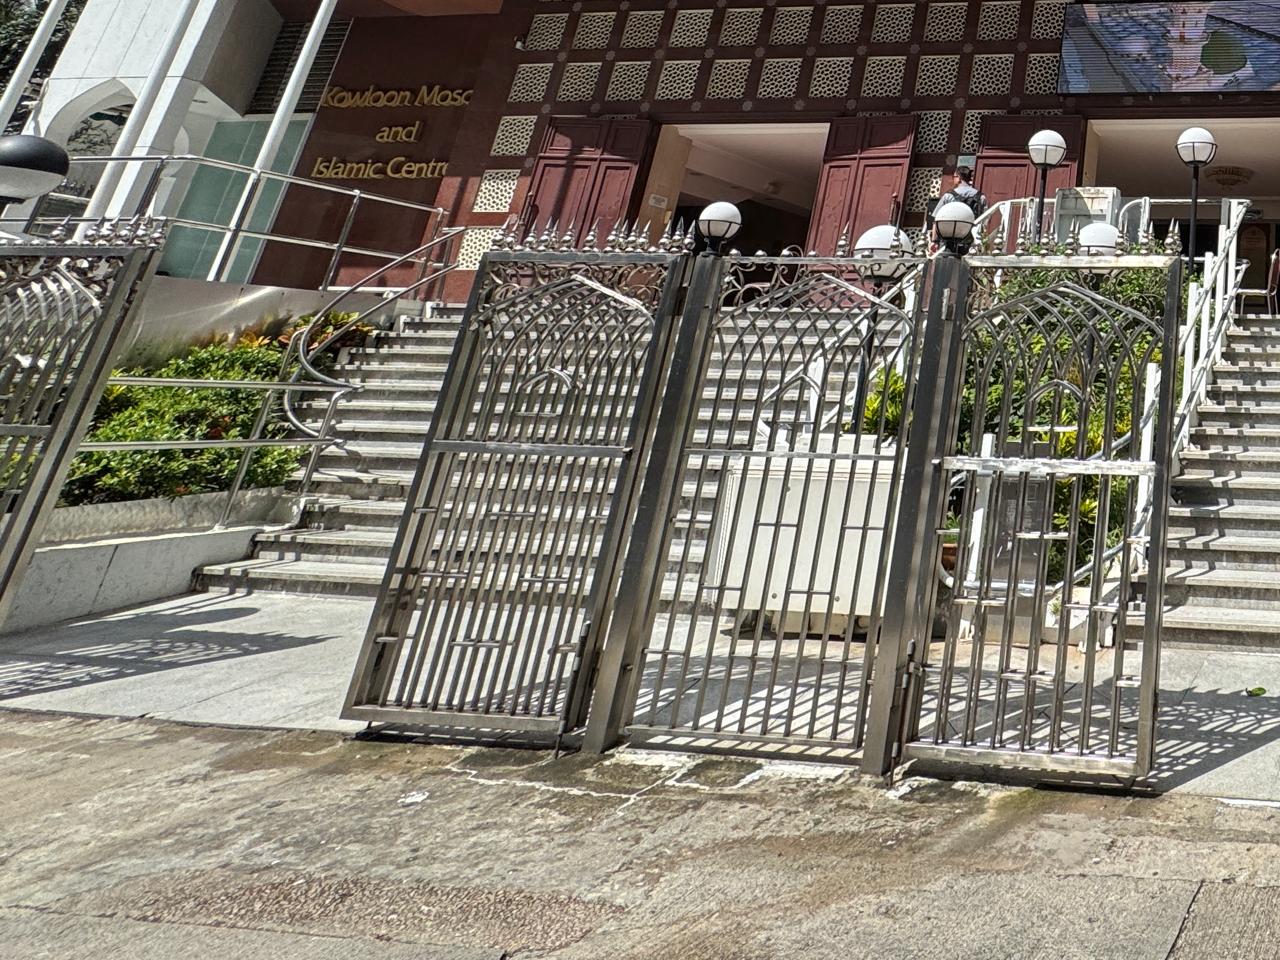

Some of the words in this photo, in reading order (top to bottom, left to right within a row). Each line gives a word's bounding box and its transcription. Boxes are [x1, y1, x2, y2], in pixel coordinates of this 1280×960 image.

[320, 85, 411, 108] Kowloon
[375, 120, 420, 143] and
[311, 157, 385, 178] Islamic
